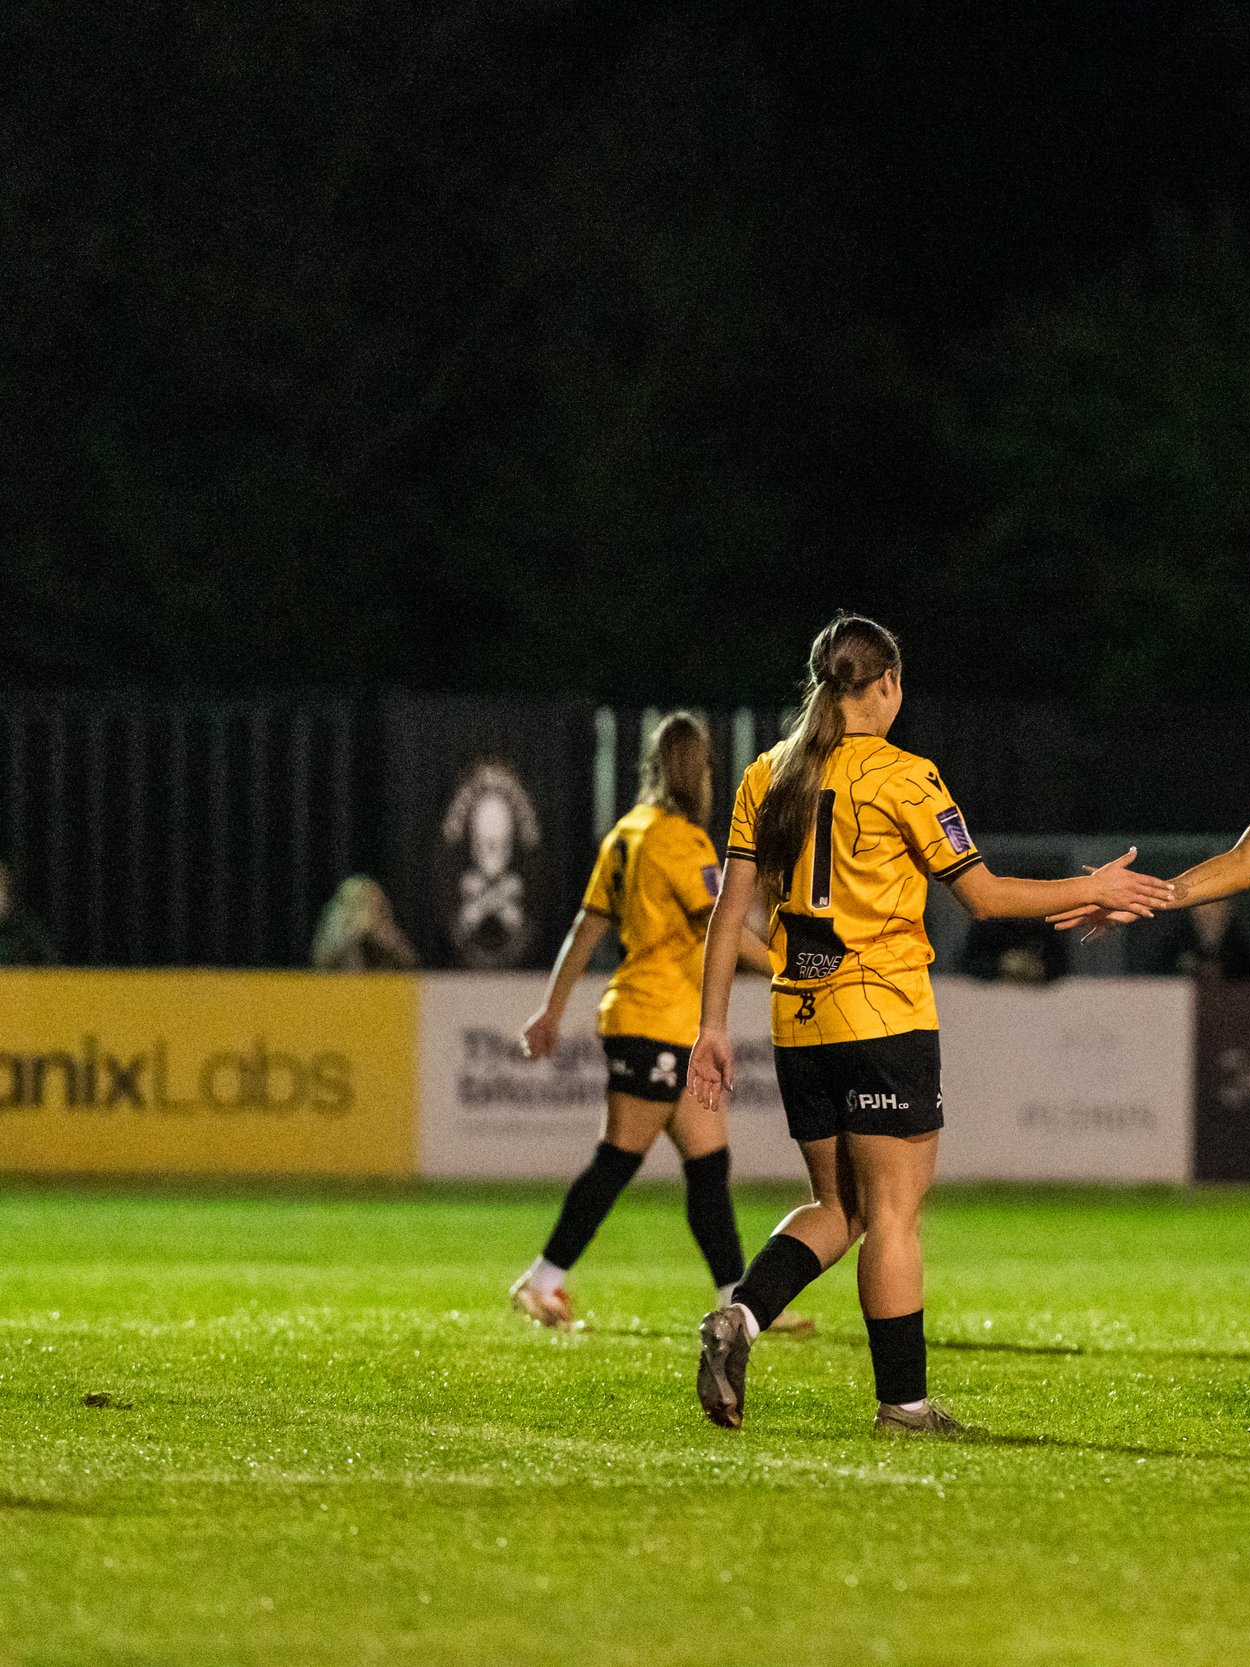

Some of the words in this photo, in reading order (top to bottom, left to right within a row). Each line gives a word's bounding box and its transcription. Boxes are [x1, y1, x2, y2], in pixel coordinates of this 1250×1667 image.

[796, 952, 842, 968] STONE
[800, 965, 836, 979] RIDGE
[858, 1093, 897, 1110] PJH
